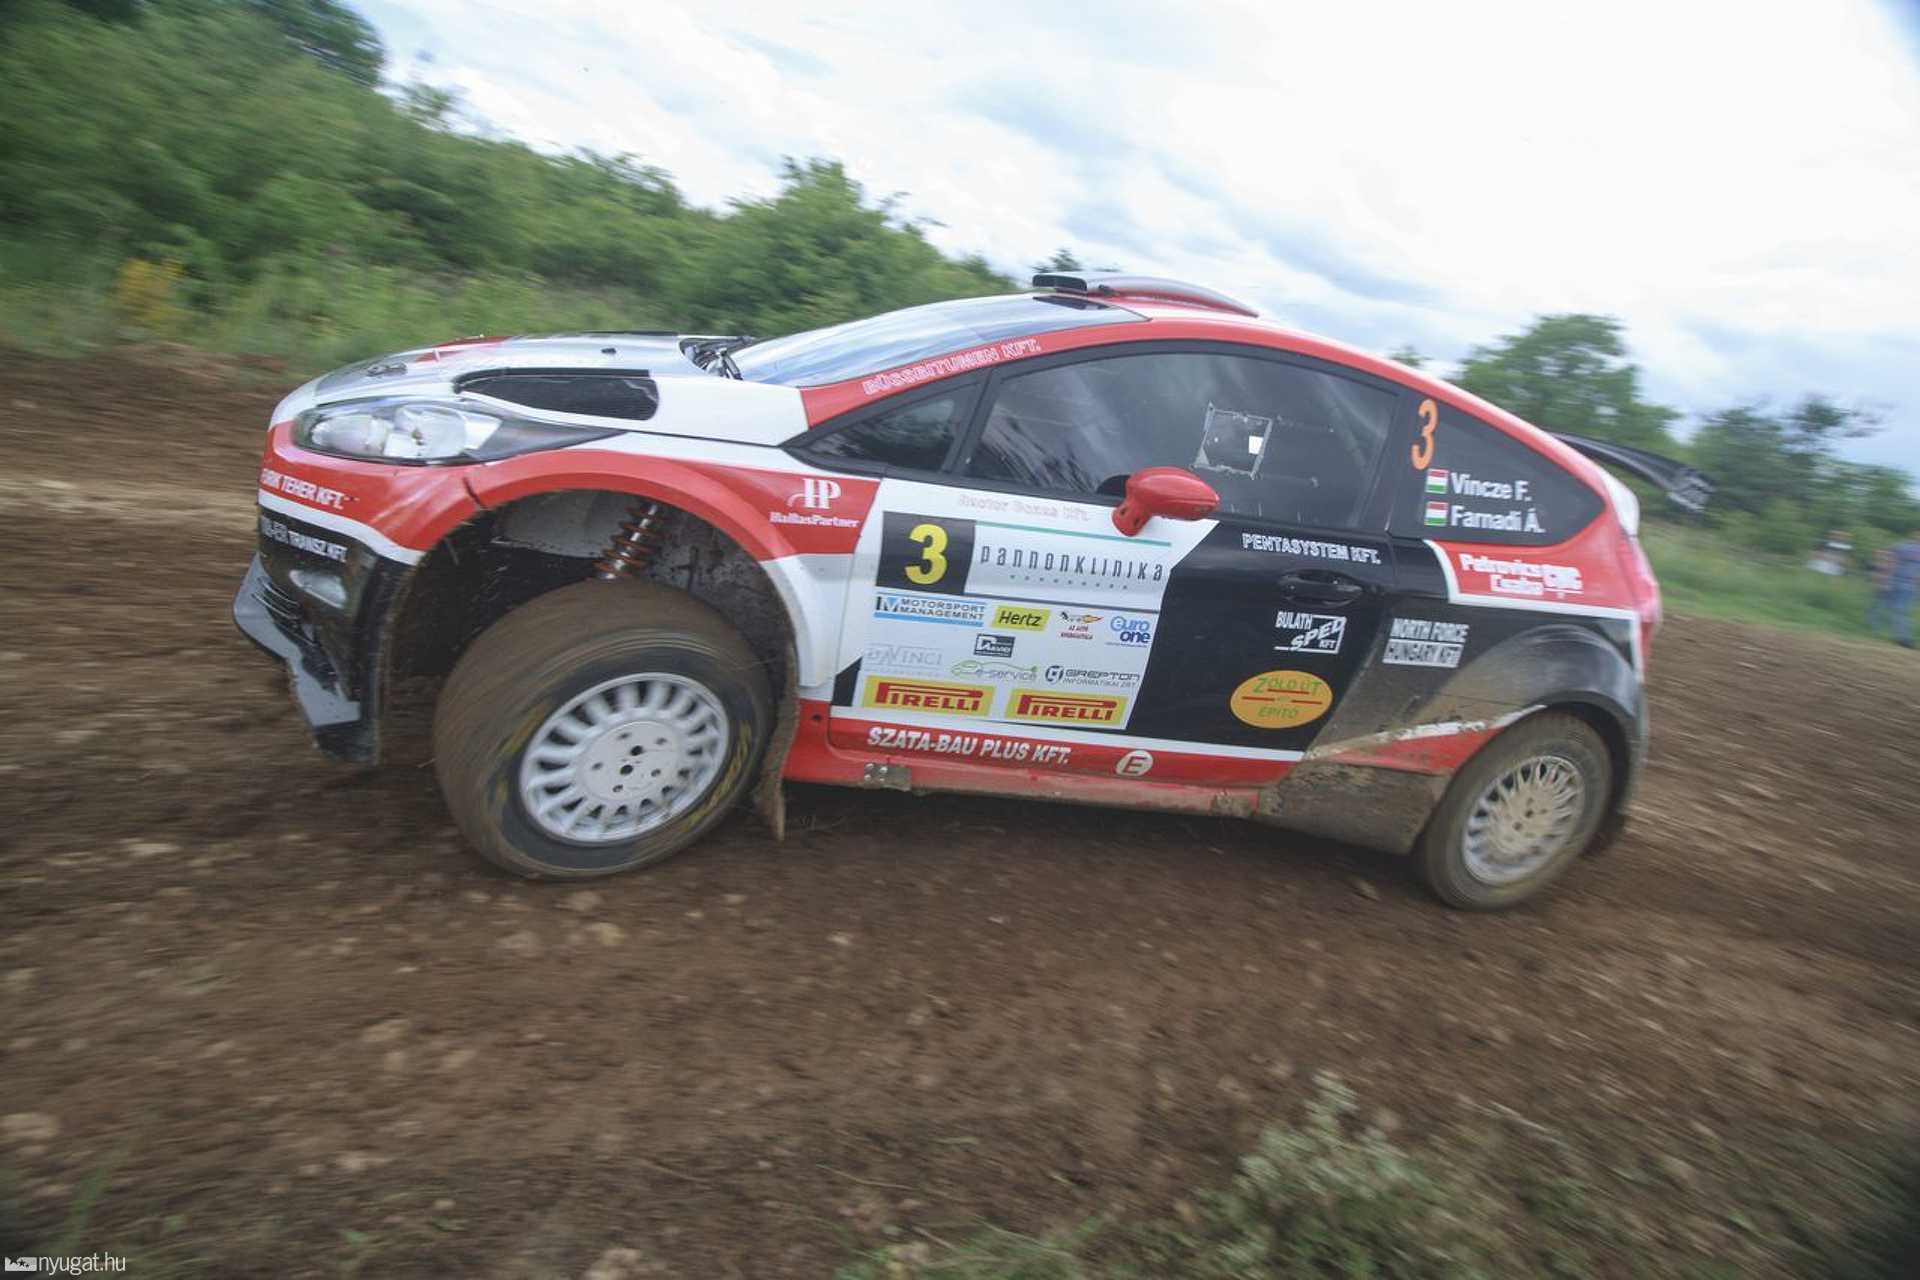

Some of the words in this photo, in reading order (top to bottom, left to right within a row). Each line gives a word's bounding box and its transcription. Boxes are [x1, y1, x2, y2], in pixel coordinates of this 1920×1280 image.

[1412, 398, 1439, 470] 3
[1451, 472, 1512, 500] Vincze
[1514, 480, 1532, 502] F.
[1451, 505, 1522, 532] Farnadi
[1524, 508, 1546, 533] Á.
[904, 523, 949, 585] 3
[1241, 533, 1350, 560] PENTASYSTEM
[1351, 546, 1381, 565] KFT.
[900, 606, 985, 620] MANAGEMENT
[901, 598, 985, 613] MOTORSPORT
[998, 610, 1042, 628] Hertz
[1275, 611, 1313, 630] BULATH
[1291, 618, 1344, 652] SPED
[1119, 631, 1151, 645] one
[875, 682, 984, 712] PIRELLI
[1017, 694, 1118, 722] PIRELLI
[868, 727, 978, 756] SZATA-BAU
[981, 738, 1029, 761] PLUS
[1032, 745, 1073, 766] KFT.
